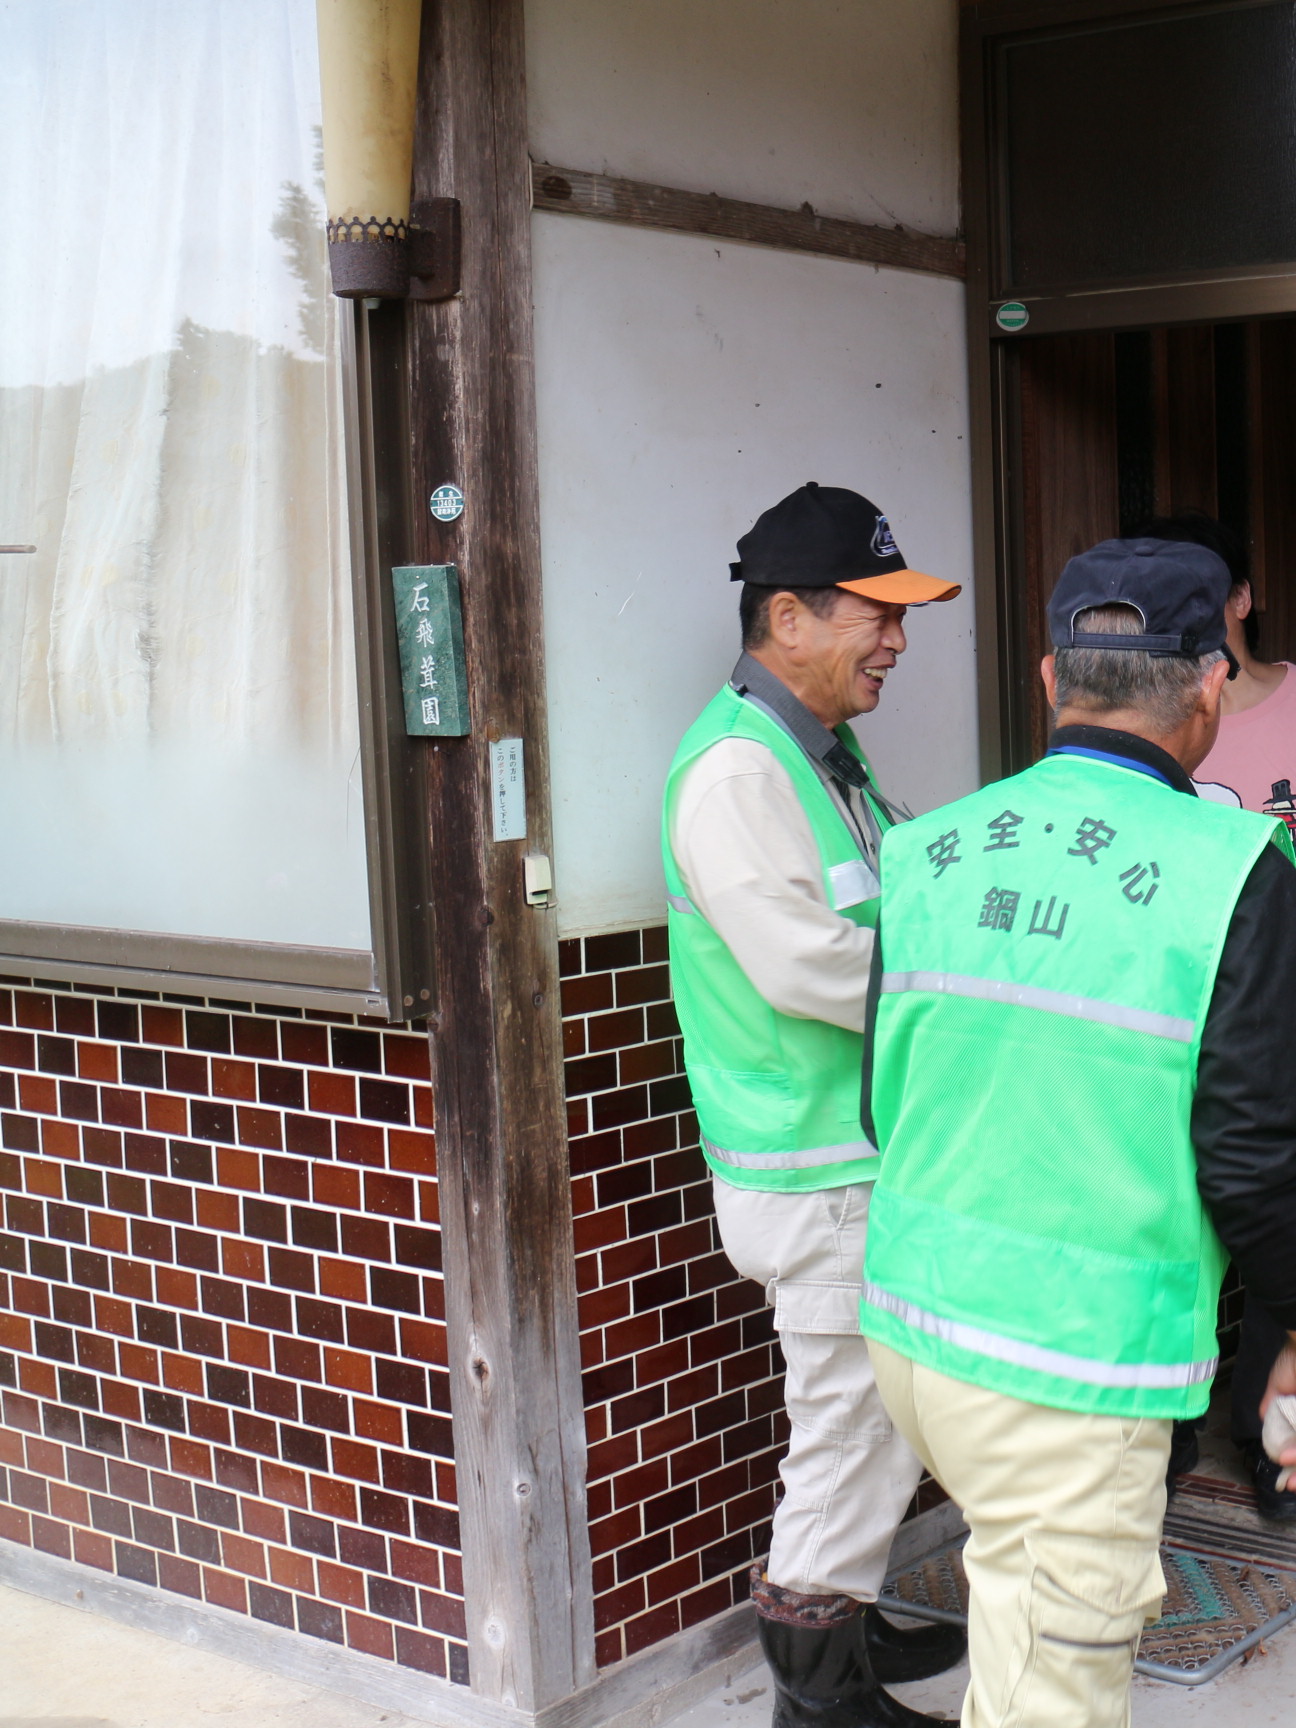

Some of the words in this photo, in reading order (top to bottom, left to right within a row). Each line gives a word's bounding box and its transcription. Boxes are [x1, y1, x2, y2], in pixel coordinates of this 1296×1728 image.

[411, 582, 440, 725] 石飛茸園
[509, 746, 517, 782] ご用の方は
[977, 886, 1071, 940] 鍋山
